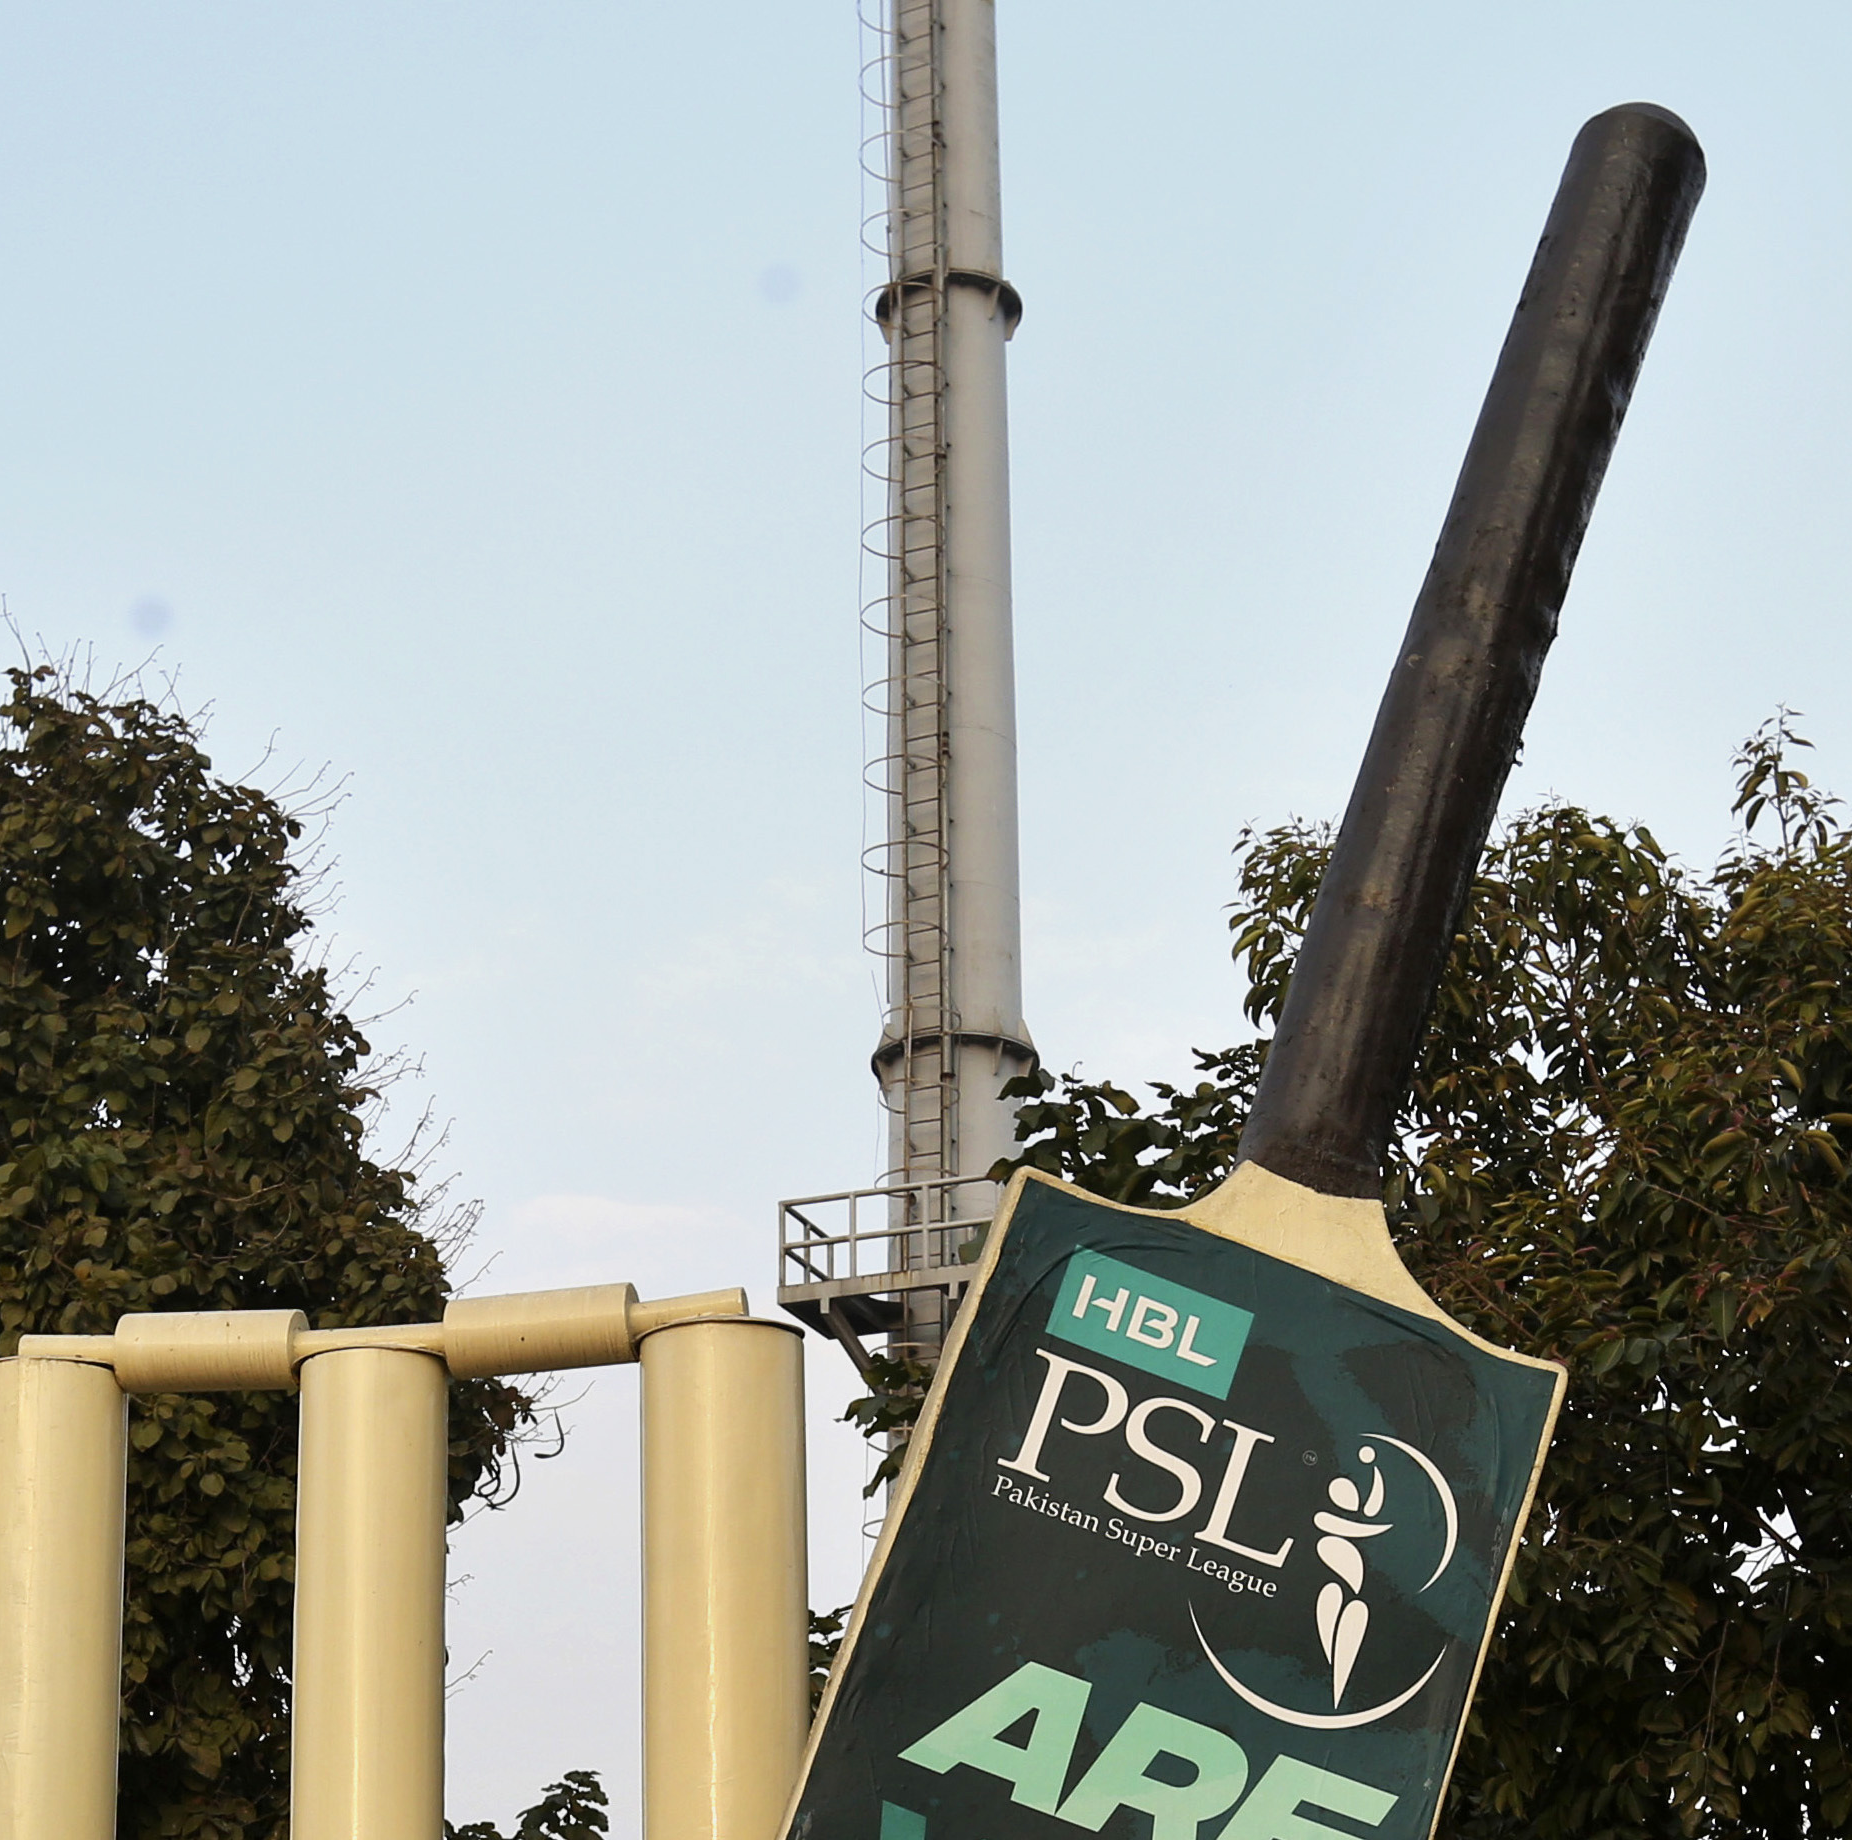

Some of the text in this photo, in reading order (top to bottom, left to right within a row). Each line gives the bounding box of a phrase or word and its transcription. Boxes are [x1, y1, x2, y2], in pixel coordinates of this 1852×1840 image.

[1072, 1273, 1218, 1367] HBL
[996, 1347, 1295, 1568] PSL
[991, 1474, 1278, 1598] Pakistan Super League
